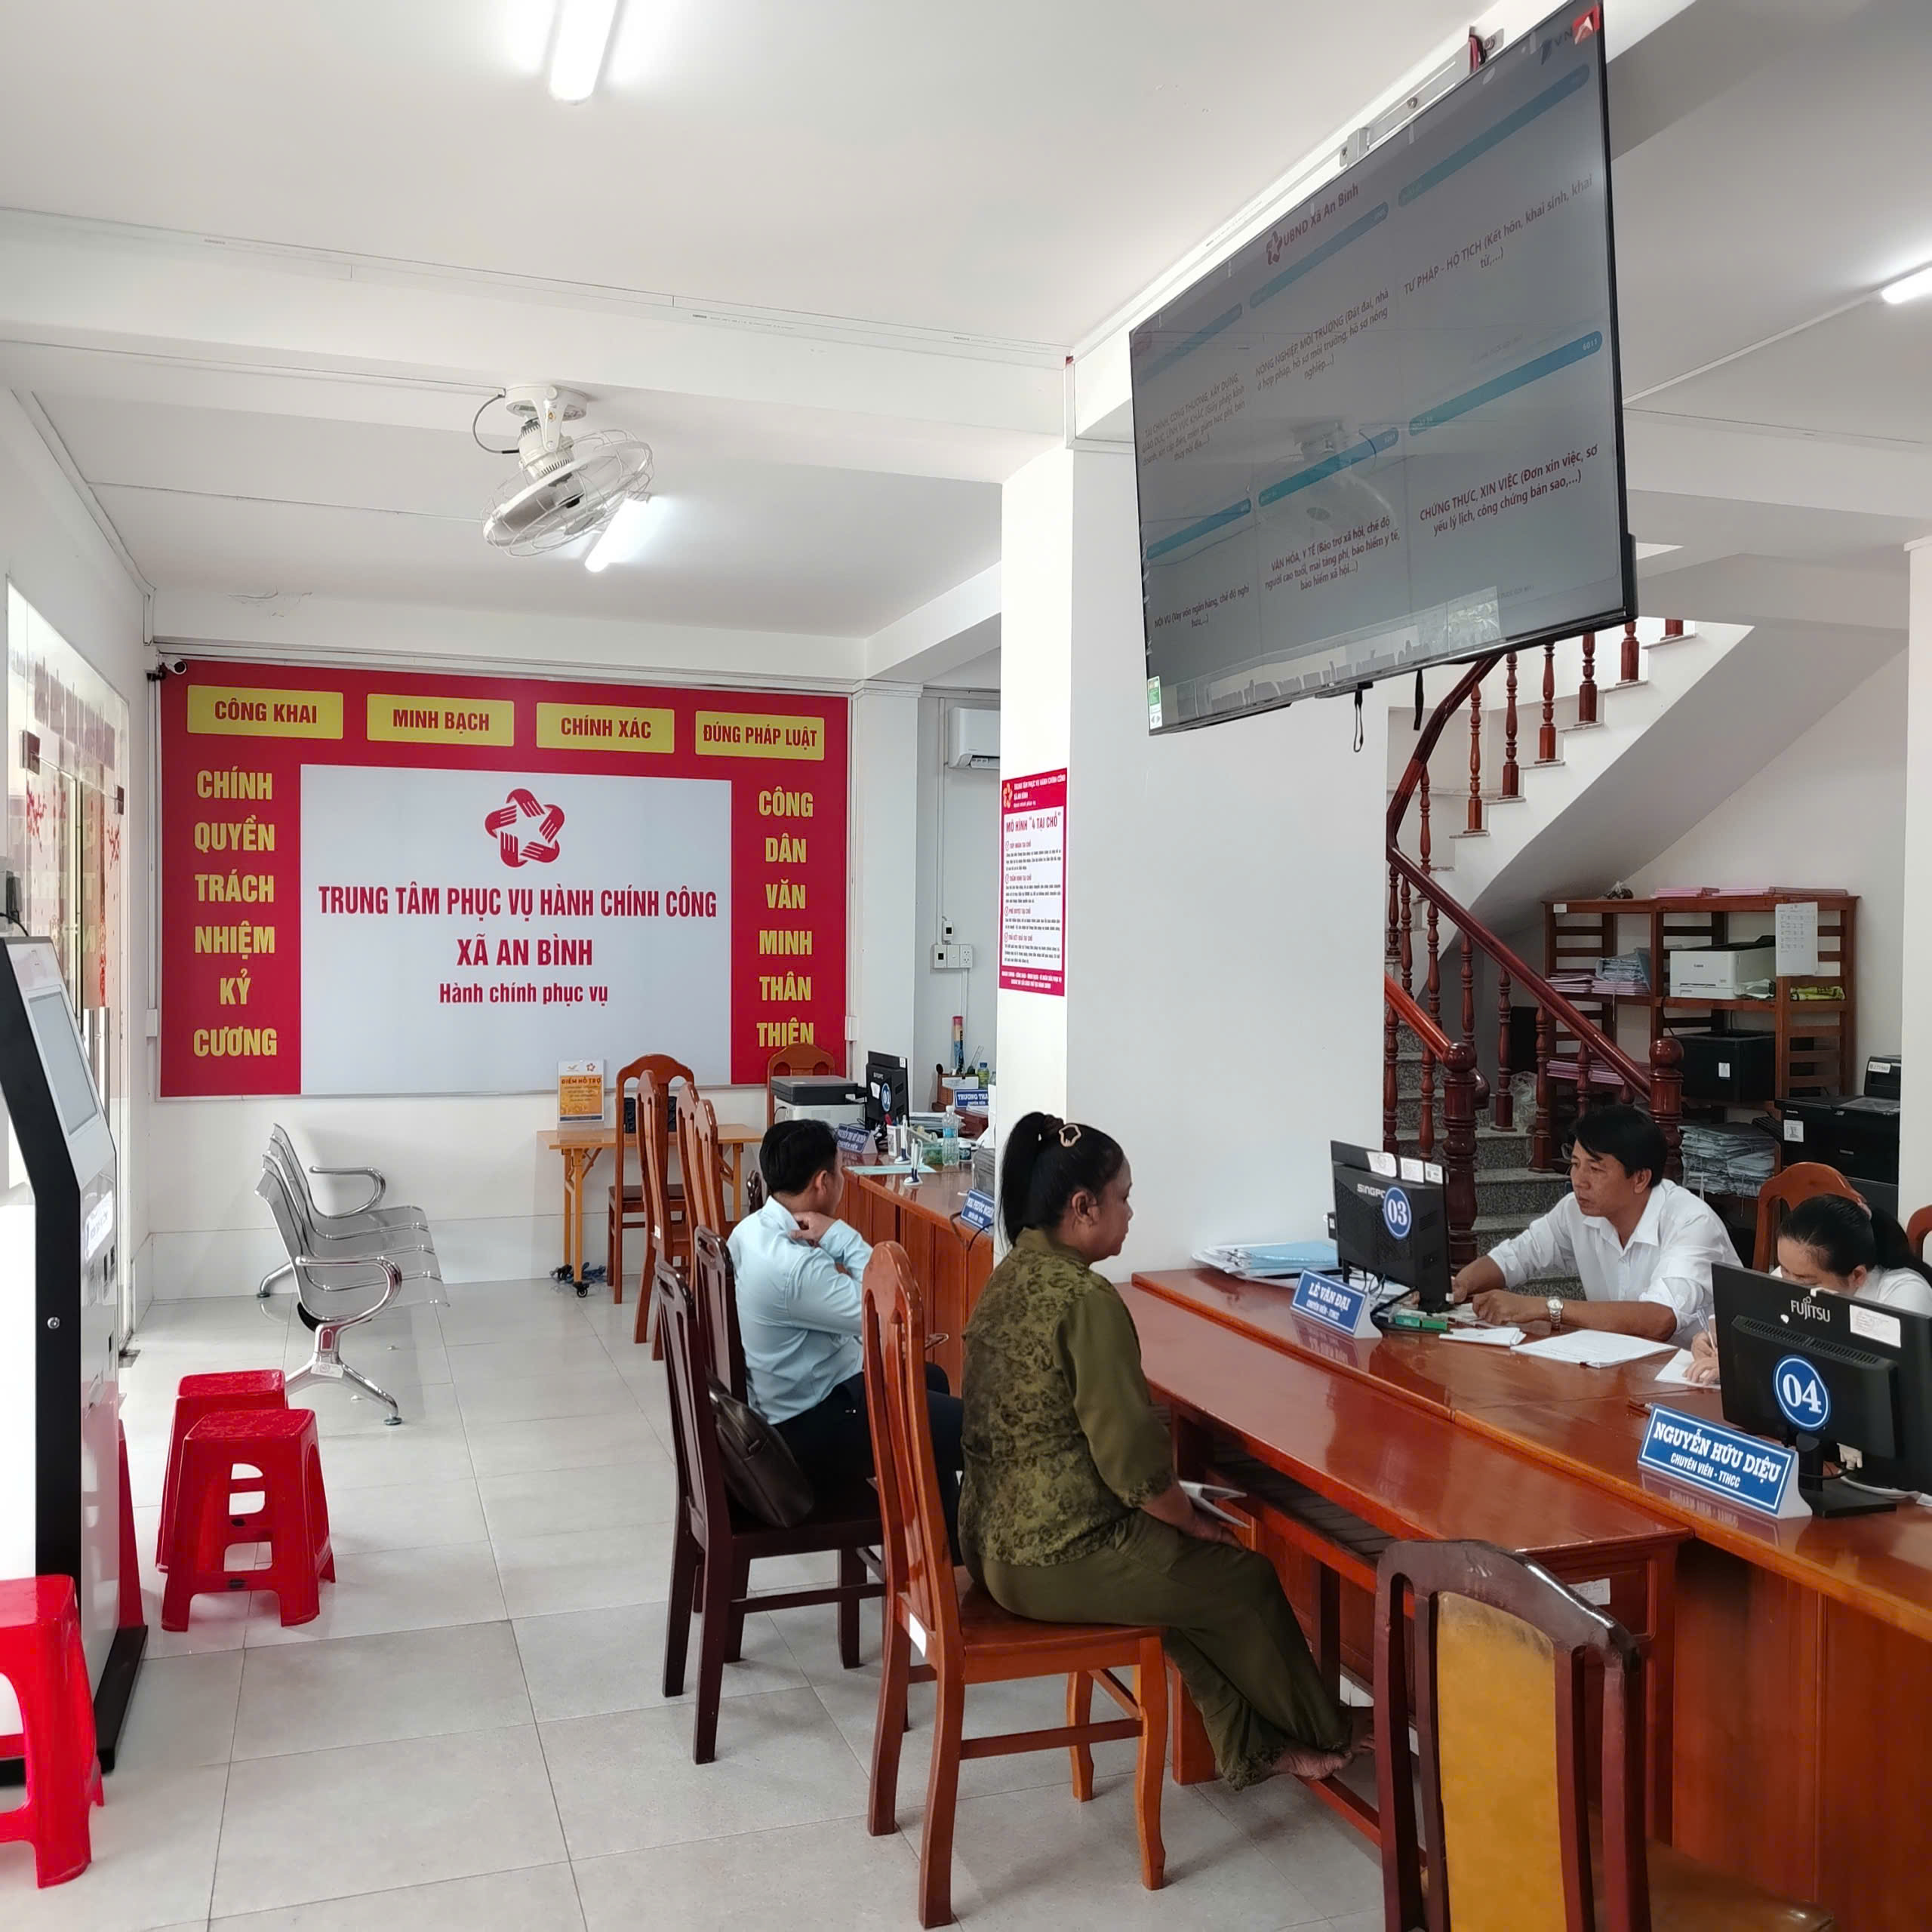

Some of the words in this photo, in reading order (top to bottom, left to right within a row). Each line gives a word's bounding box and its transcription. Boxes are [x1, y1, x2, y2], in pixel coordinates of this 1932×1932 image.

[1283, 219, 1309, 247] UBND
[1311, 210, 1321, 228] Xã
[1323, 202, 1336, 218] An
[1337, 183, 1359, 208] Bình
[1403, 277, 1417, 296] TƯ
[1417, 264, 1439, 288] PHÁP
[1446, 251, 1460, 270] HỘ
[1460, 240, 1481, 262] TỊCH
[1484, 229, 1502, 250] (Kết
[1503, 217, 1523, 238] hôn,
[1524, 203, 1545, 224] khai
[1546, 190, 1569, 211] sinh,
[1571, 175, 1592, 196] khai
[1375, 287, 1389, 306] nhà
[1301, 352, 1309, 366] sơ
[1349, 322, 1359, 337] hồ
[1359, 318, 1369, 331] sơ
[1369, 306, 1389, 326] nông
[1420, 498, 1451, 521] CHỨNG
[1451, 489, 1478, 509] THỰC,
[1480, 481, 1497, 499] XIN
[1497, 472, 1518, 492] VIỆC
[1520, 467, 1543, 485] (Đơn
[1545, 459, 1561, 474] xin
[1562, 449, 1584, 469] việc,
[1586, 442, 1599, 459] sơ
[1432, 518, 1448, 537] yếu
[1449, 515, 1458, 531] lý
[1458, 508, 1475, 527] lịch,
[1477, 501, 1499, 518] công
[1500, 488, 1528, 509] chứng
[1530, 482, 1548, 499] bản
[1270, 555, 1284, 572] VĂN
[1307, 541, 1316, 557] TẾ
[1316, 540, 1332, 556] (Bảo
[1332, 534, 1343, 548] trợ
[1343, 530, 1352, 544] xã
[1367, 517, 1380, 534] chế
[1380, 514, 1391, 530] độ
[1264, 572, 1283, 592] người
[1283, 572, 1294, 583] cao
[1309, 558, 1321, 573] mai
[1321, 554, 1338, 571] táng
[1337, 549, 1351, 565] phí,
[1351, 542, 1365, 557] bảo
[1365, 534, 1384, 551] hiểm
[1300, 578, 1312, 592] bảo
[1313, 570, 1330, 586] hiểm
[1330, 568, 1339, 580] xã
[214, 698, 267, 723] CÔNG
[272, 703, 318, 724] KHAI
[392, 708, 439, 730] MINH
[444, 710, 491, 734] BẠCH
[560, 715, 613, 738] CHÍNH
[618, 716, 652, 740] XÁC
[703, 721, 741, 744] ĐÚNG
[745, 722, 781, 746] PHÁP
[785, 726, 817, 751] LUẬT
[197, 765, 272, 800] CHÍNH
[758, 786, 814, 818] CÔNG
[193, 814, 275, 852] QUYỀN
[1015, 817, 1028, 832] HÌNH
[764, 832, 808, 863] DÂN
[194, 869, 274, 903] TRÁCH
[318, 885, 388, 915] TRUNG
[395, 881, 440, 915] TÂM
[447, 887, 501, 922] PHỤC
[508, 888, 531, 922] VỤ
[540, 882, 594, 917] HÀNH
[600, 884, 659, 918] CHÍNH
[666, 885, 717, 918] CÔNG
[764, 878, 807, 909] VĂN
[194, 920, 275, 961] NHIỆM
[457, 933, 489, 967] XÃ
[496, 938, 529, 967] AN
[537, 934, 593, 967] BÌNH
[759, 930, 813, 955] MINH
[219, 968, 252, 1005] KỶ
[439, 982, 484, 1004] Hành
[489, 982, 537, 1004] chính
[543, 985, 584, 1008] phục
[589, 985, 609, 1008] vụ
[759, 970, 812, 1001] THÂN
[193, 1025, 278, 1057] CƯƠNG
[882, 1089, 891, 1105] 01
[1386, 1198, 1408, 1226] 03
[1308, 1281, 1321, 1298] LÊ
[1320, 1286, 1337, 1305] VĂN
[1334, 1293, 1352, 1312] ĐẠI
[1790, 1297, 1832, 1323] FUJITSU
[1782, 1373, 1823, 1414] 04
[1654, 1421, 1711, 1457] NGUYỄN
[1711, 1440, 1744, 1467] HỮU
[1746, 1455, 1781, 1484] DIỆU
[1670, 1452, 1697, 1472] CHUYÊN
[1697, 1457, 1715, 1478] VIÊN
[1718, 1468, 1742, 1488] TTHCC
